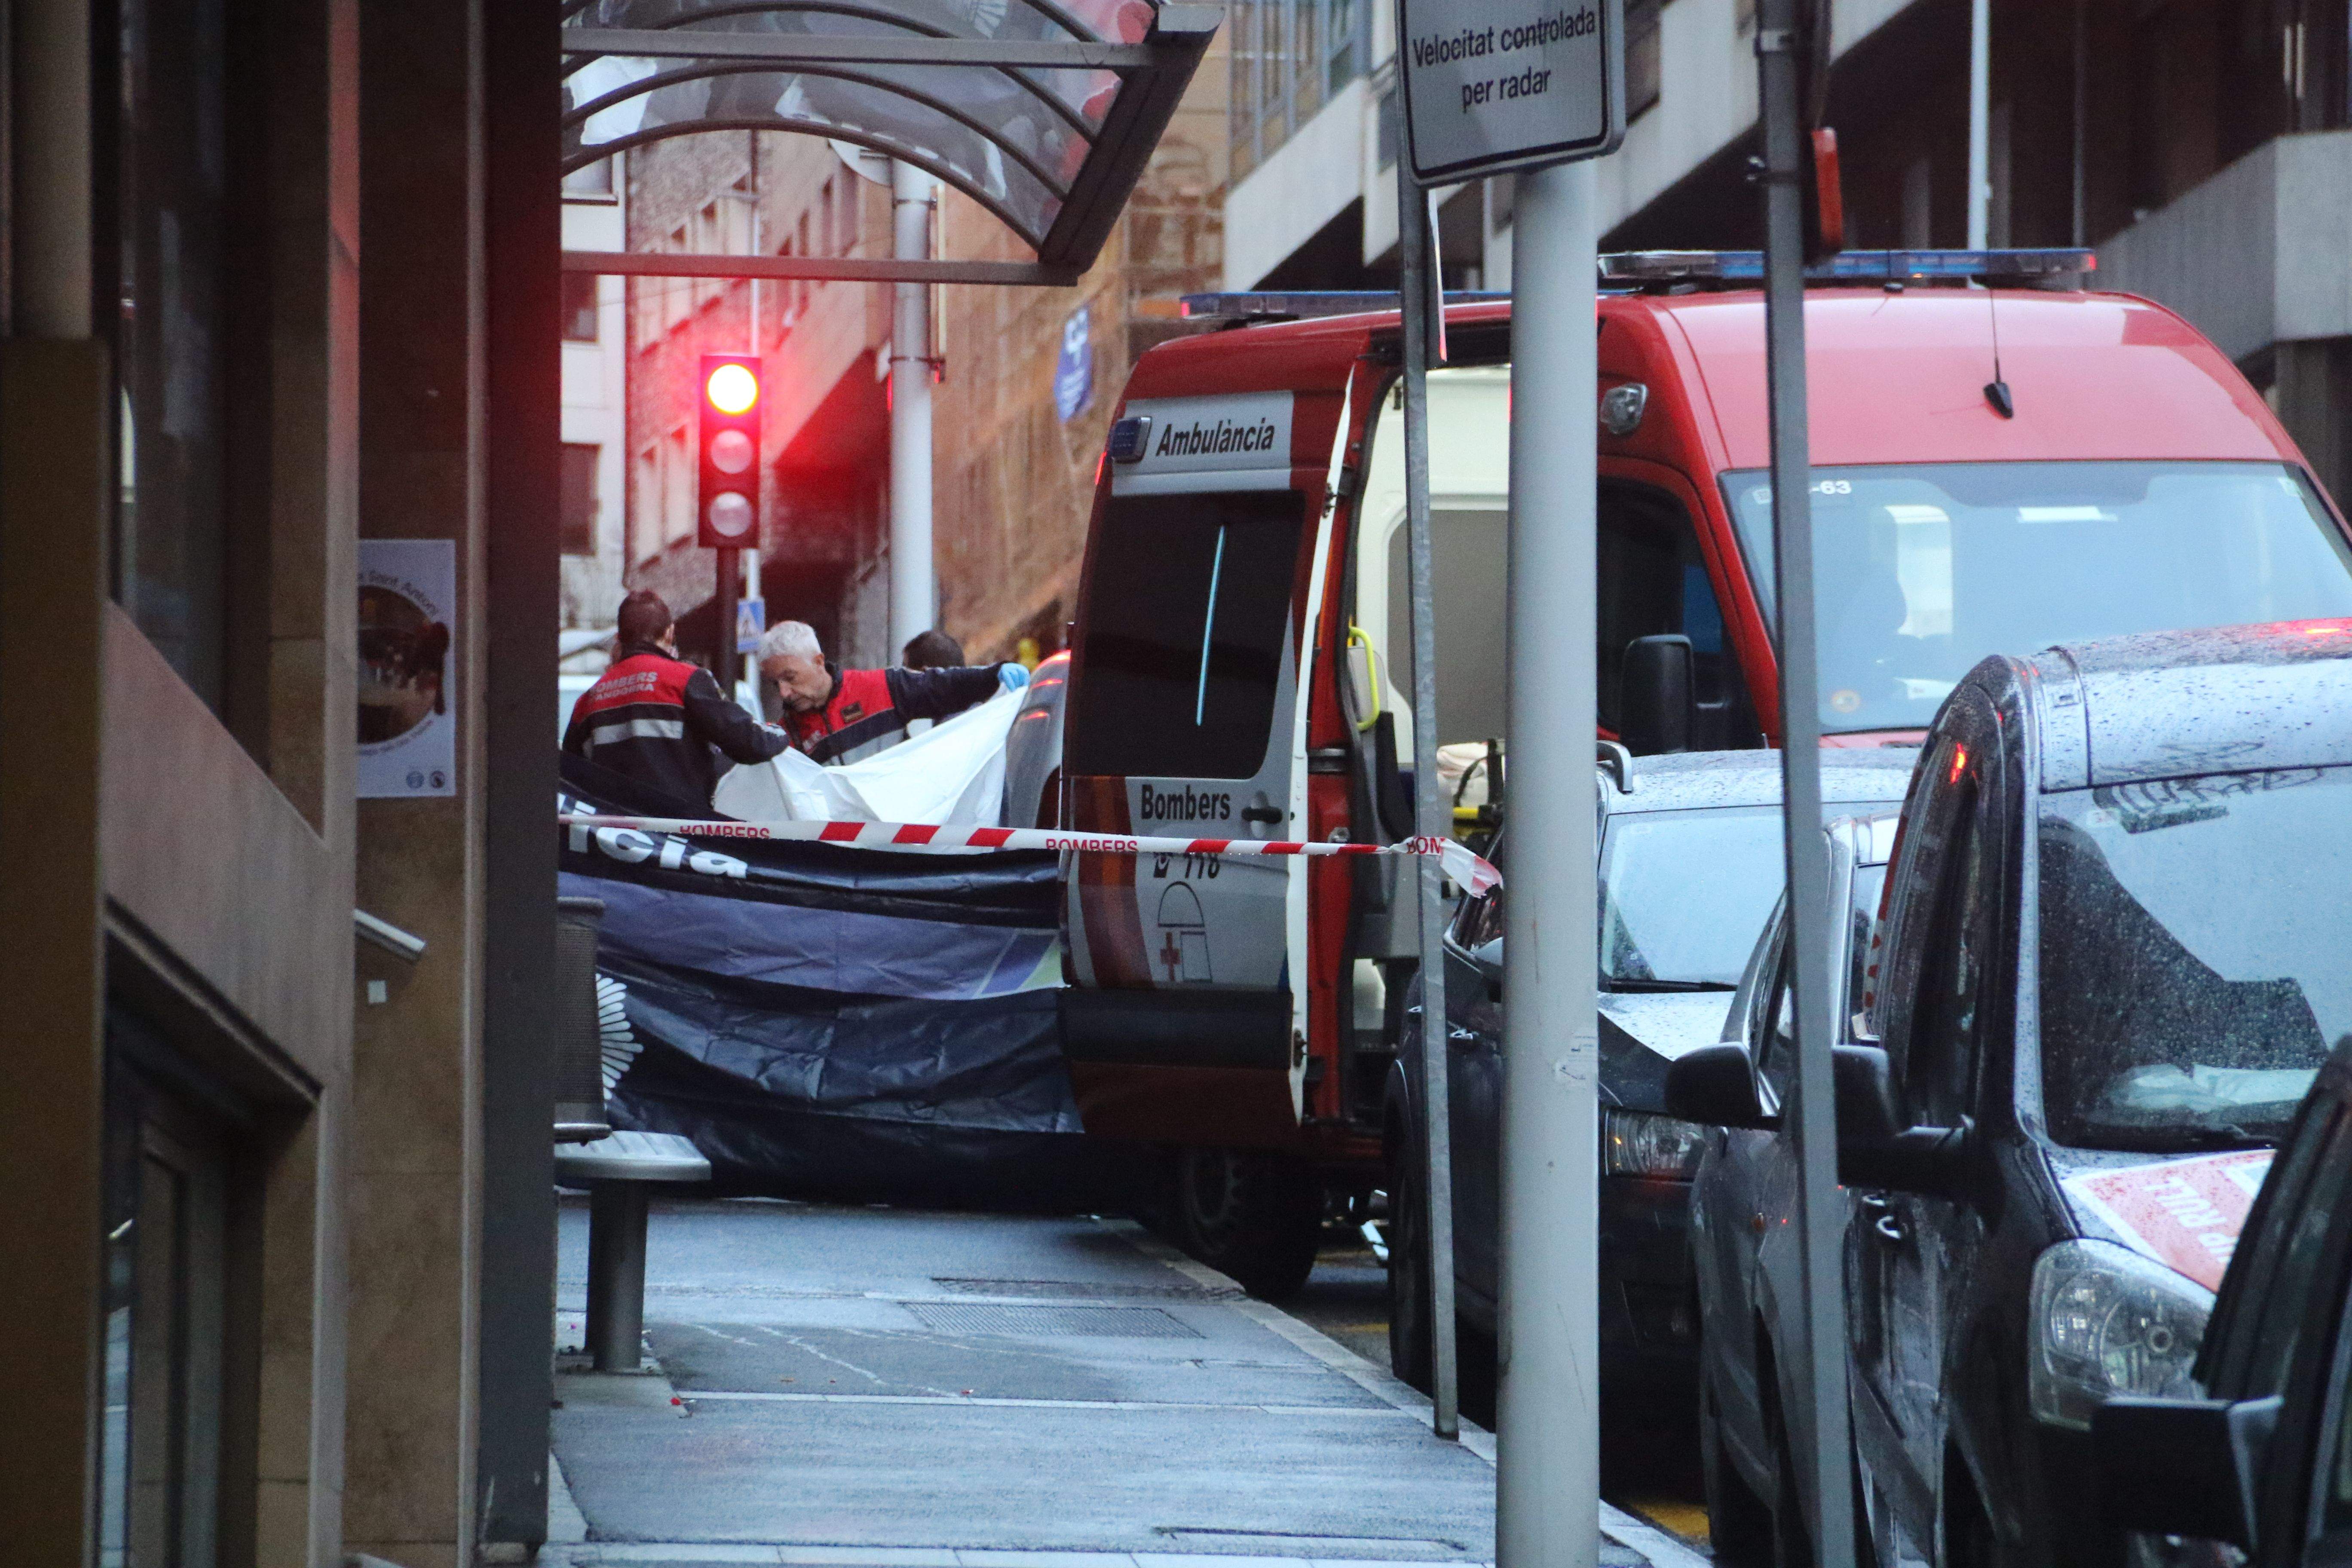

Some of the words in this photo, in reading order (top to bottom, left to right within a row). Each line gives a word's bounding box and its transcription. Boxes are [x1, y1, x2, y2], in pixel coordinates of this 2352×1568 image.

[1412, 26, 1494, 68] Velocitat
[1500, 5, 1595, 52] controlada
[1462, 79, 1494, 113] per
[1499, 65, 1551, 100] radar
[1155, 417, 1275, 456] Ambulància
[1141, 784, 1231, 820] Bombers
[1046, 838, 1138, 851] BOMBERS
[2141, 1176, 2228, 1228] RULL
